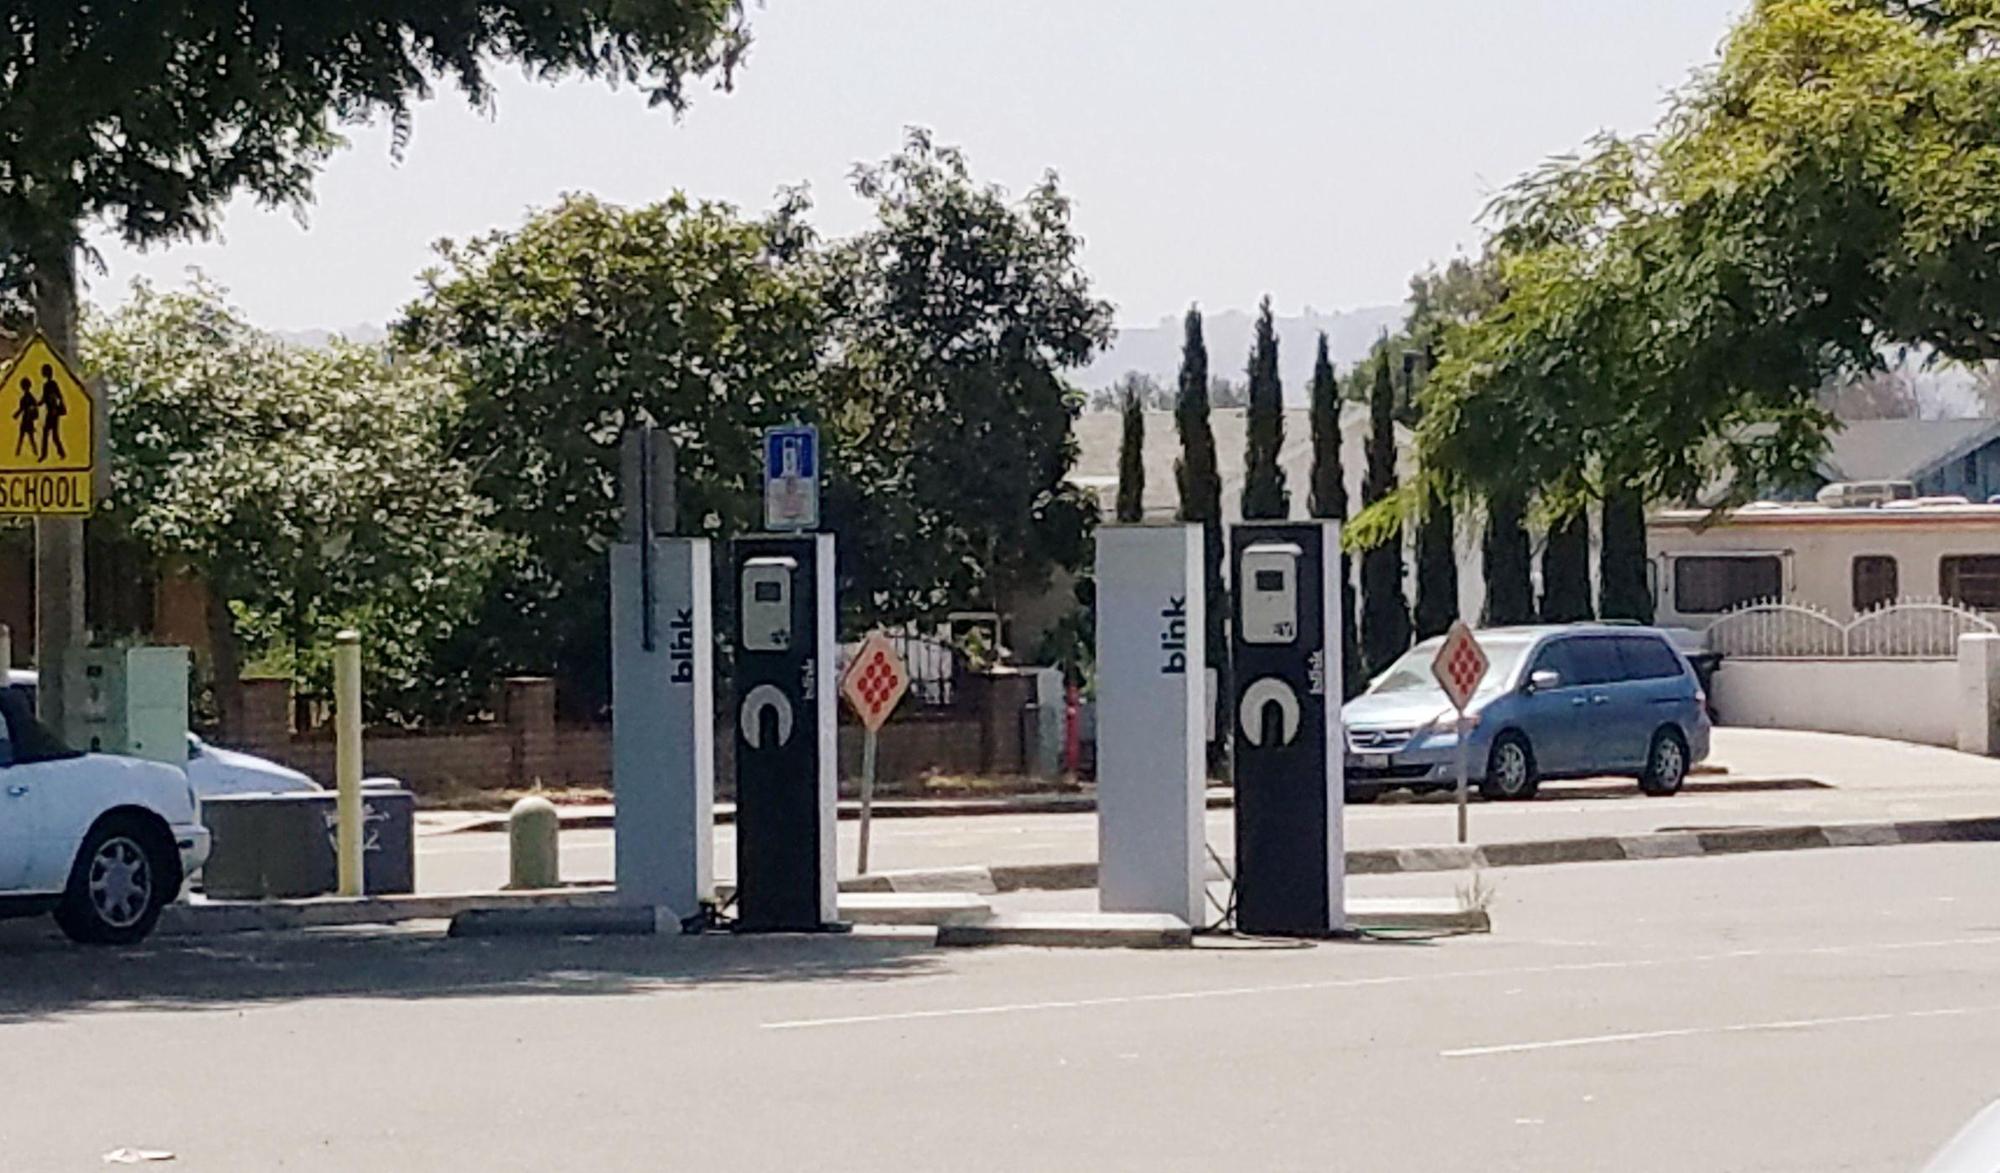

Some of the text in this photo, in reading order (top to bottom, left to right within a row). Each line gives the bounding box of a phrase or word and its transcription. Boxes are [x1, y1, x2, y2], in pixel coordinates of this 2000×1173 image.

[0, 475, 84, 508] SCHOOL
[669, 607, 693, 684] blink
[1161, 595, 1186, 674] blink
